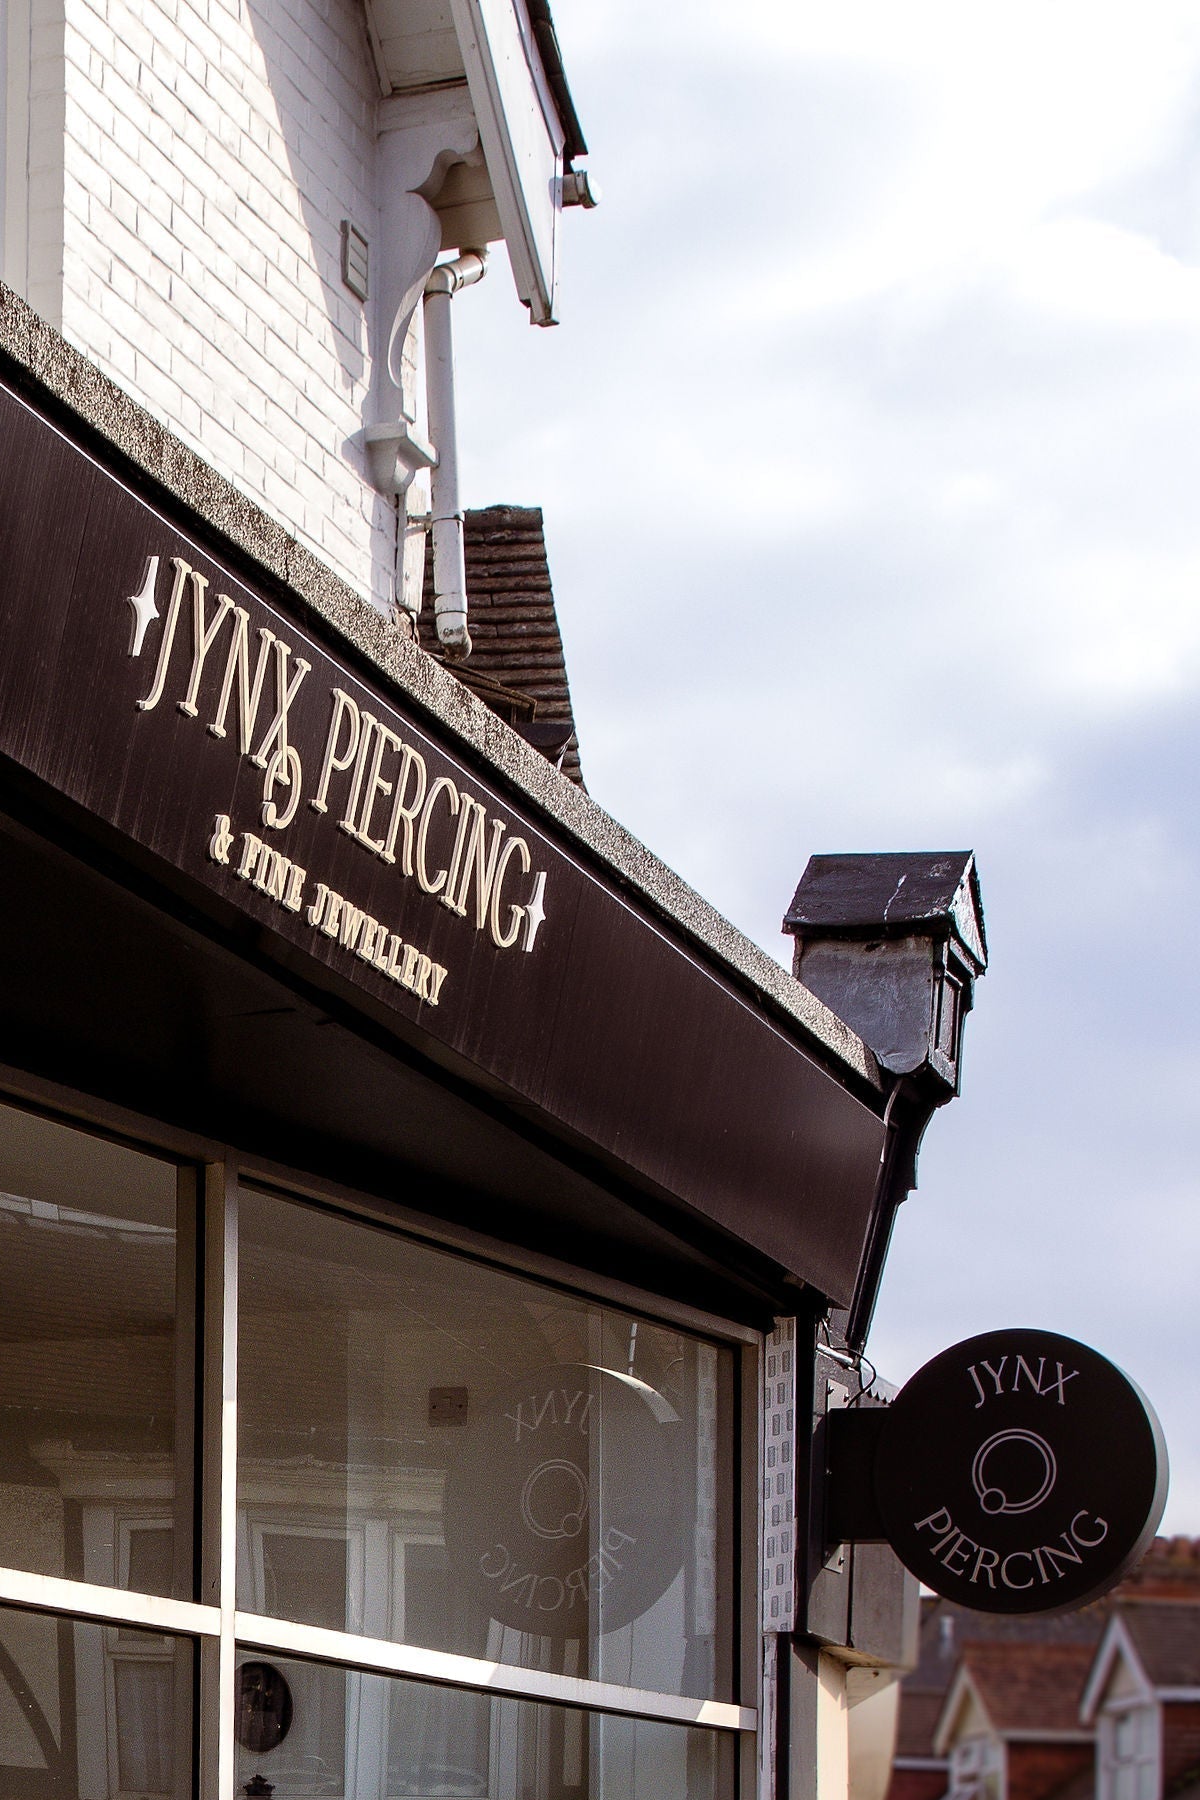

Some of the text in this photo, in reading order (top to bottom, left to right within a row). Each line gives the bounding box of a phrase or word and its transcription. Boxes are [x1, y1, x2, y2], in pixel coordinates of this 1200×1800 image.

[136, 557, 532, 949] JYNX PIERCING
[236, 832, 308, 914] FINE
[306, 882, 449, 1007] JEWELLERY
[967, 1354, 1080, 1409] JYNX
[913, 1506, 1109, 1589] PIERCING
